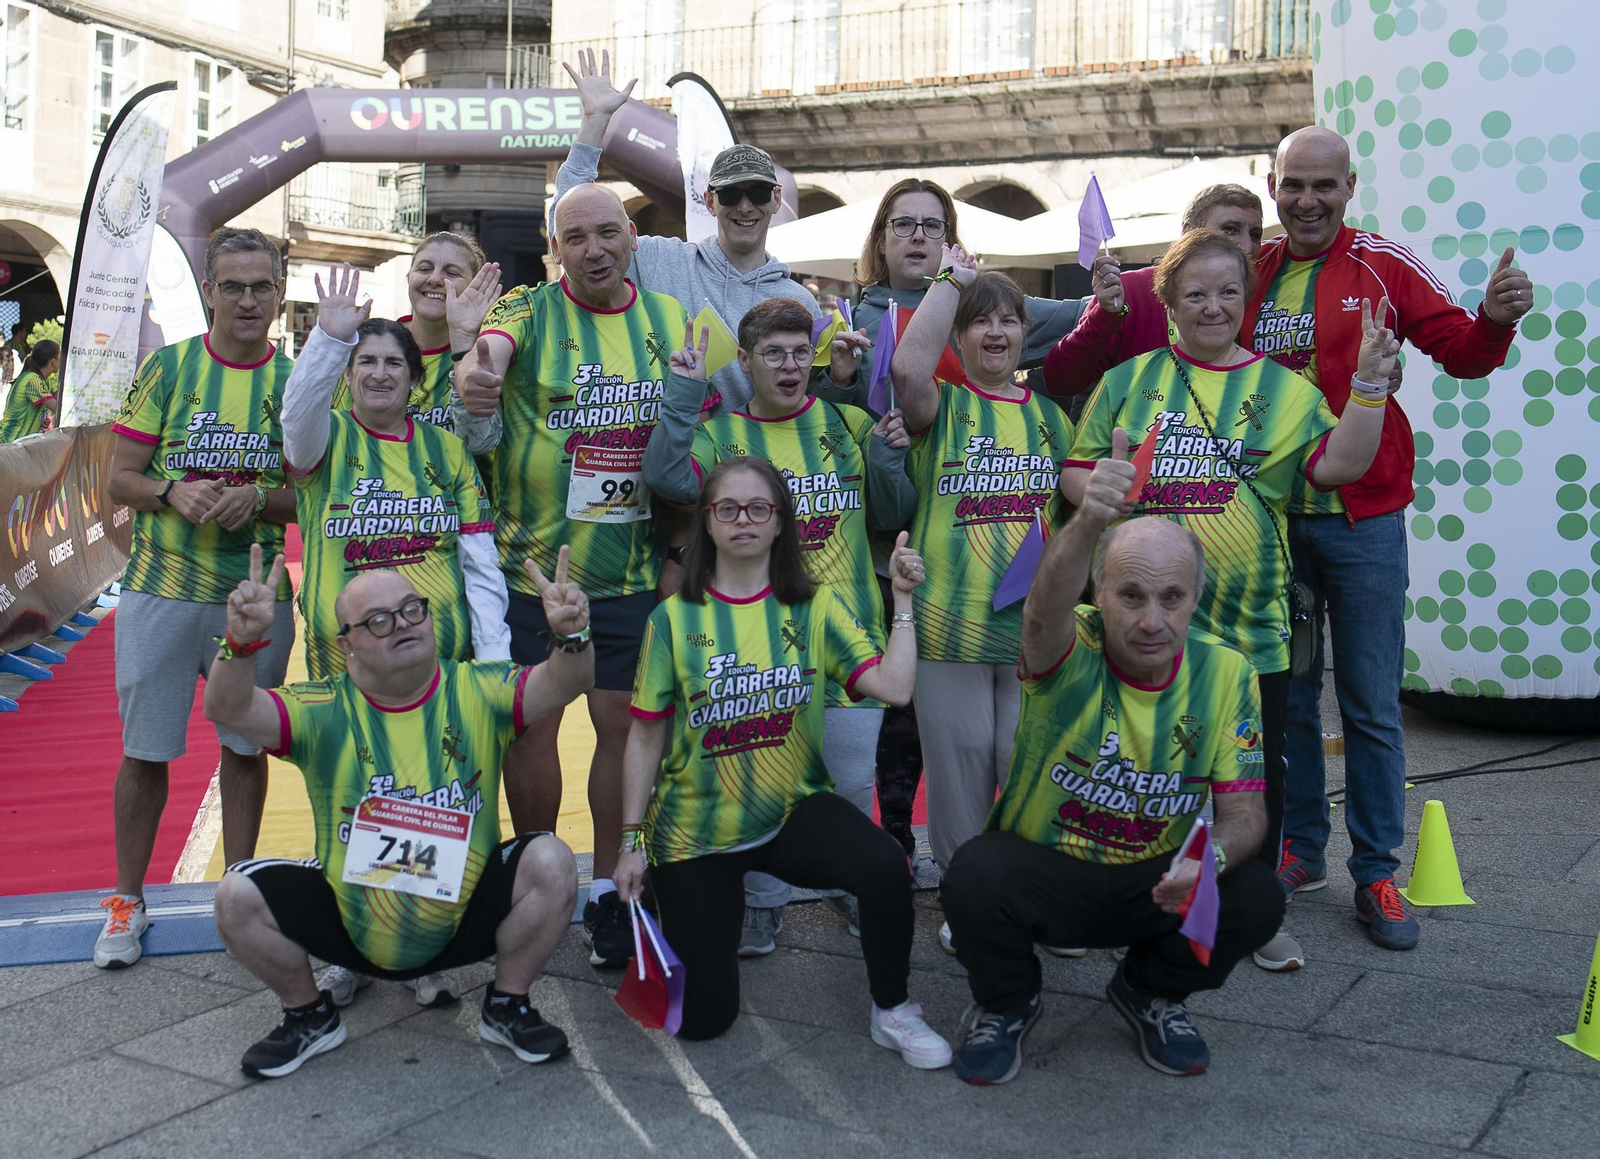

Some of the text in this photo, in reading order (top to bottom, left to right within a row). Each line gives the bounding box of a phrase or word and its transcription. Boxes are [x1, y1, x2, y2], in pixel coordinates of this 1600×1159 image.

[350, 96, 583, 131] OURENSE
[85, 284, 94, 293] de
[106, 273, 138, 285] Central
[95, 302, 100, 312] y
[572, 363, 603, 385] 3ª
[595, 374, 623, 385] EDICIÓN
[576, 379, 665, 406] CARRERA
[186, 411, 218, 432] 3ª
[206, 422, 234, 432] EDICIÓN
[546, 404, 635, 430] GUARDIA
[1172, 424, 1204, 436] EDICIÓN
[186, 433, 269, 450] CARRERA
[964, 435, 995, 454] 3ª
[984, 447, 1013, 456] EDICIÓN
[166, 452, 280, 470] GUARDIA CIVIL
[585, 459, 612, 467] GUARDIA
[965, 455, 1054, 473] CARRERA
[350, 477, 384, 497] 3ª
[373, 490, 402, 499] EDICIÓN
[601, 479, 634, 501] 99
[937, 473, 1024, 496] GUARDIA
[351, 496, 445, 515] CARRERA
[814, 490, 861, 513] CIVIL
[955, 493, 1051, 518] OURENSE
[324, 514, 459, 538] GUARDIA CIVIL
[344, 535, 441, 562] OURENSE
[704, 652, 737, 679] 3ª
[728, 663, 757, 675] EDICIÓN
[710, 664, 801, 700] CARRERA
[391, 803, 422, 817] CARRERA
[423, 809, 437, 819] DEL
[437, 812, 458, 823] PILAR
[1142, 792, 1203, 818] CIVIL
[370, 809, 464, 834] GUARDIA CIVIL DE OURENSE
[376, 835, 437, 872] 714
[1584, 978, 1598, 1025] KIPSTA
